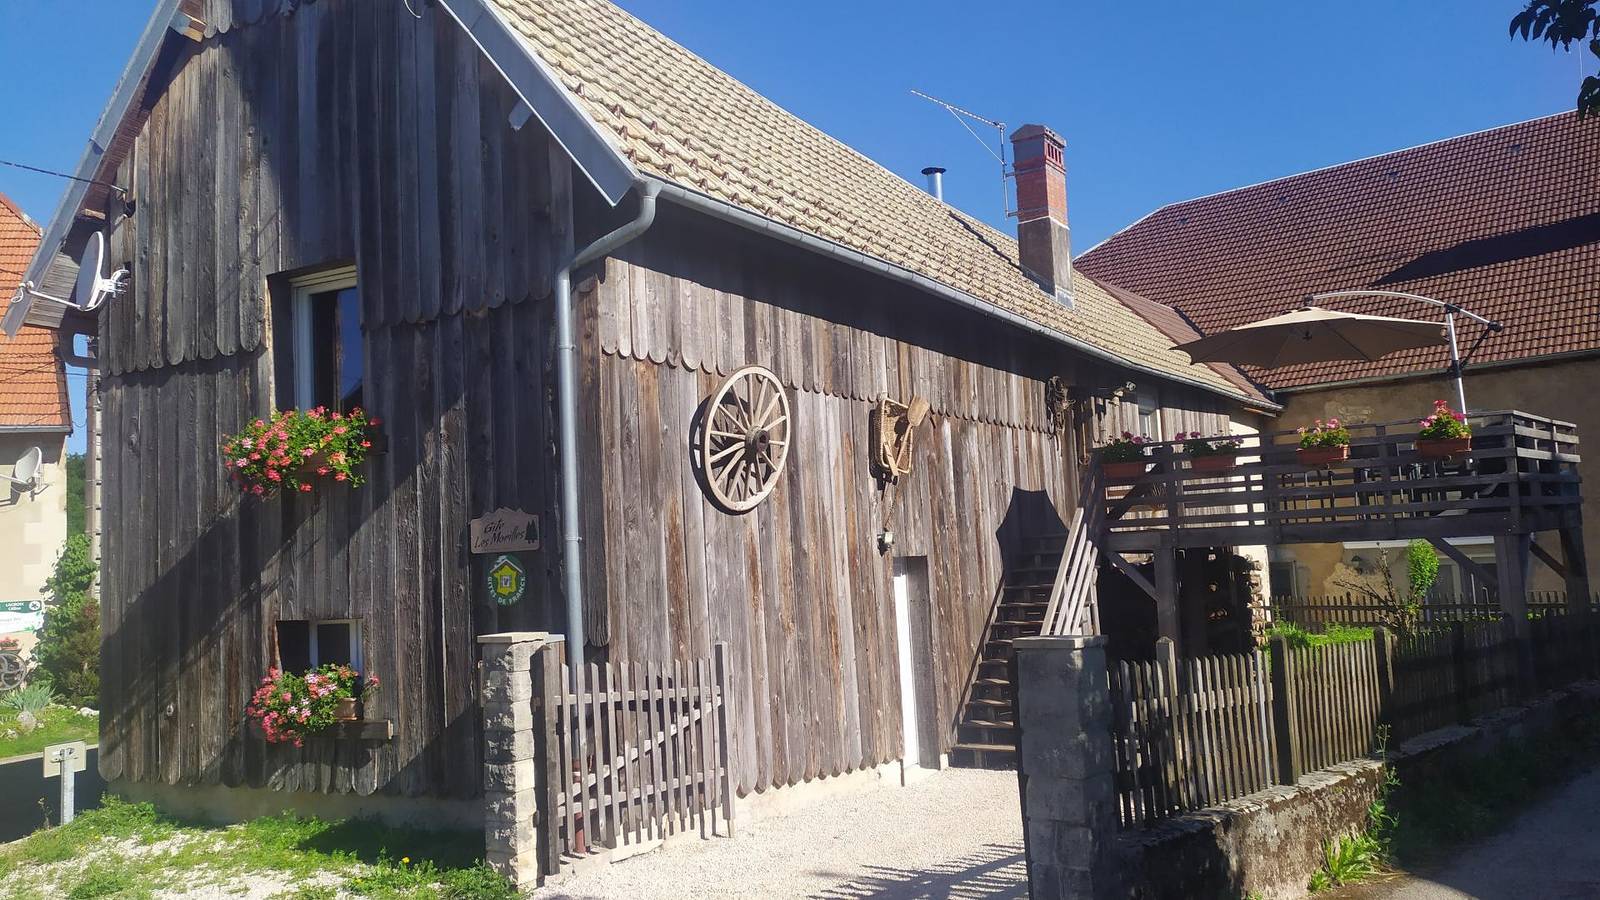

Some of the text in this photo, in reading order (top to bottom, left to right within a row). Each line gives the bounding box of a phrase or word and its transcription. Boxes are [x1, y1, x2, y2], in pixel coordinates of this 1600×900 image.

[474, 536, 490, 549] Les
[497, 597, 507, 606] DE
[508, 576, 526, 605] FRANCE
